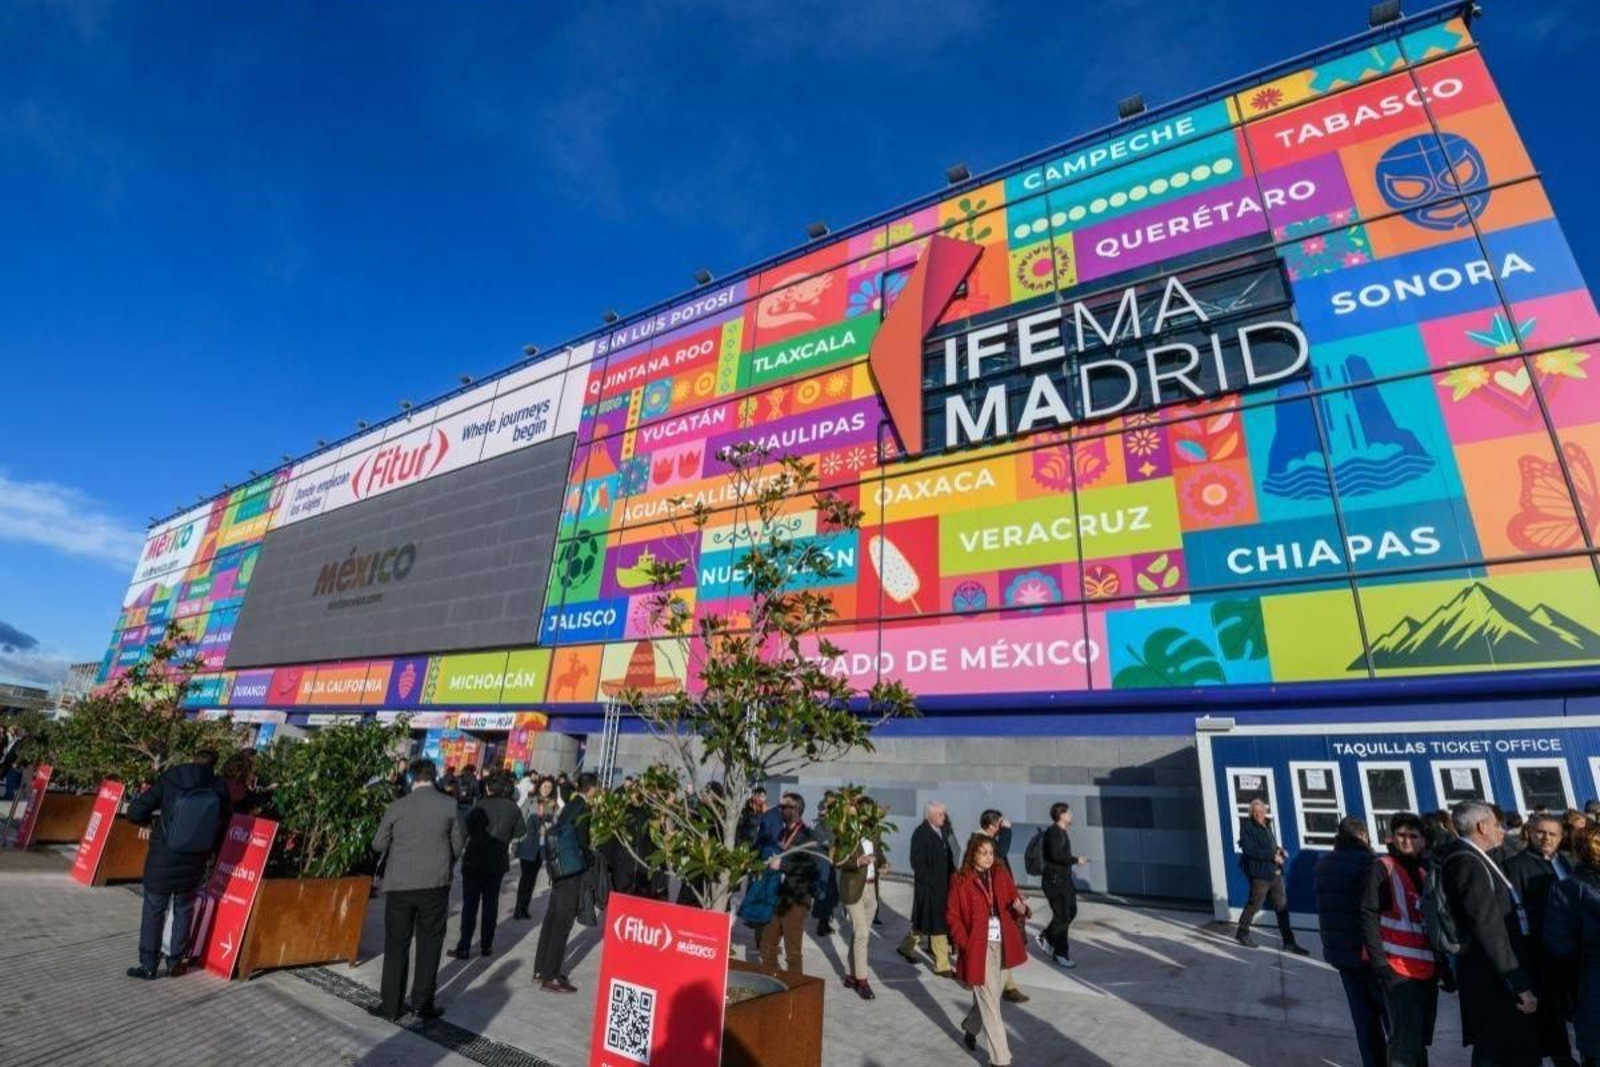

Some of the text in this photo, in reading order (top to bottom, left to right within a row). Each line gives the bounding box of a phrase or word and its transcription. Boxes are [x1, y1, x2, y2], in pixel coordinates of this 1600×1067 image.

[1275, 78, 1464, 148] TABASCO
[1022, 116, 1196, 191] CAMPECHE
[1095, 180, 1317, 258] QUERÉTARO
[1331, 252, 1536, 315] SONORA
[597, 287, 734, 354] SAN LUIS POTOSÍ
[943, 275, 1210, 386] IFEMA
[589, 339, 714, 395] QUINTANA ROO
[753, 330, 856, 373] TLAXCALA
[944, 320, 1309, 448] MADRID
[461, 398, 551, 443] Where journeys
[512, 417, 548, 443] begin
[642, 407, 726, 444] YUCATÁN
[874, 468, 995, 507] OAXACA
[959, 506, 1152, 553] VERACRUZ
[1227, 527, 1441, 574] CHIAPAS
[548, 608, 617, 632] JALISCO
[450, 667, 536, 690] MICHOACÁN
[788, 639, 1099, 677] TADO DE MÉXICO
[233, 684, 267, 697] DURANGO
[327, 679, 382, 693] CALIFORNIA
[1333, 738, 1562, 757] TAQUILLAS TICKET OFFICE
